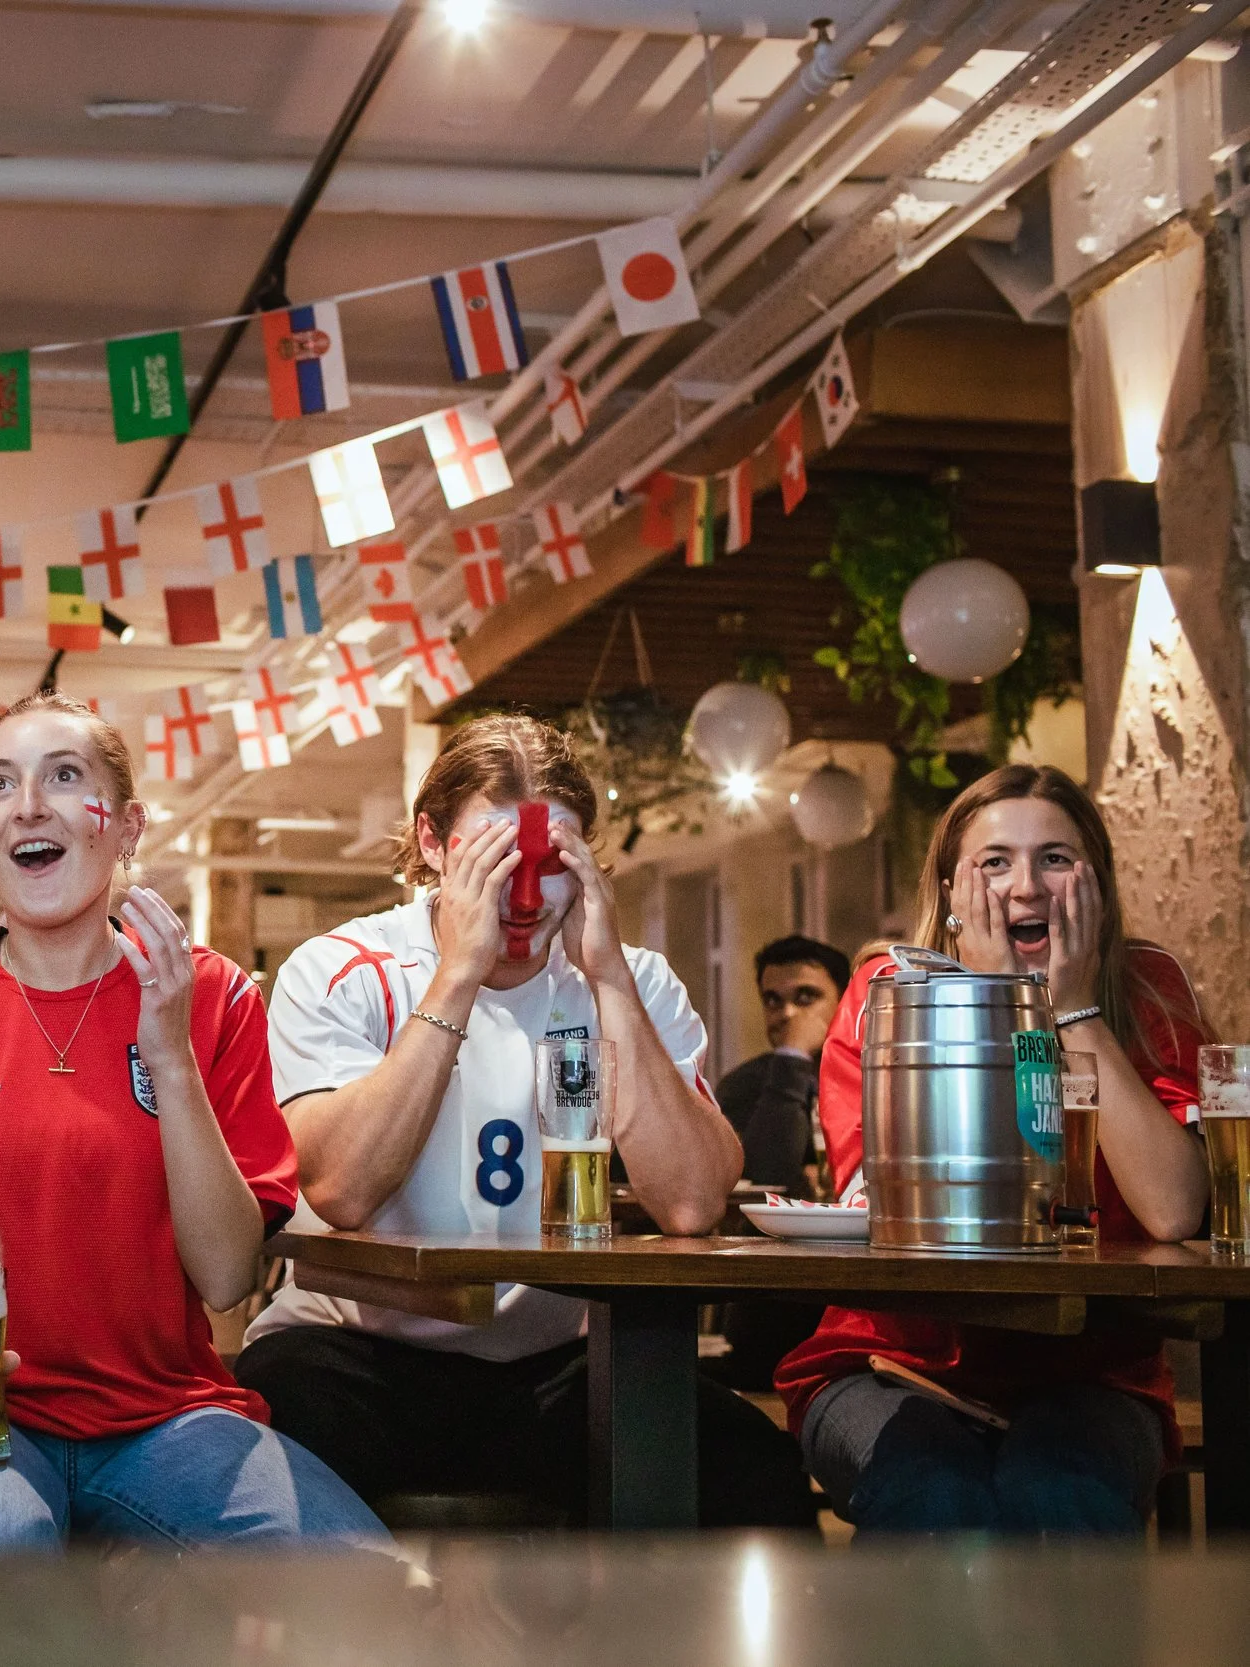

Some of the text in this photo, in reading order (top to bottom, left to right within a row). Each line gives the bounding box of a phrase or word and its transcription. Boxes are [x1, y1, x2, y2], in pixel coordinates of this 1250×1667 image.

[545, 1029, 585, 1040] NGLAND
[1031, 1072, 1061, 1103] HAZ
[556, 1096, 592, 1108] BREWDOG
[476, 1119, 524, 1207] 8
